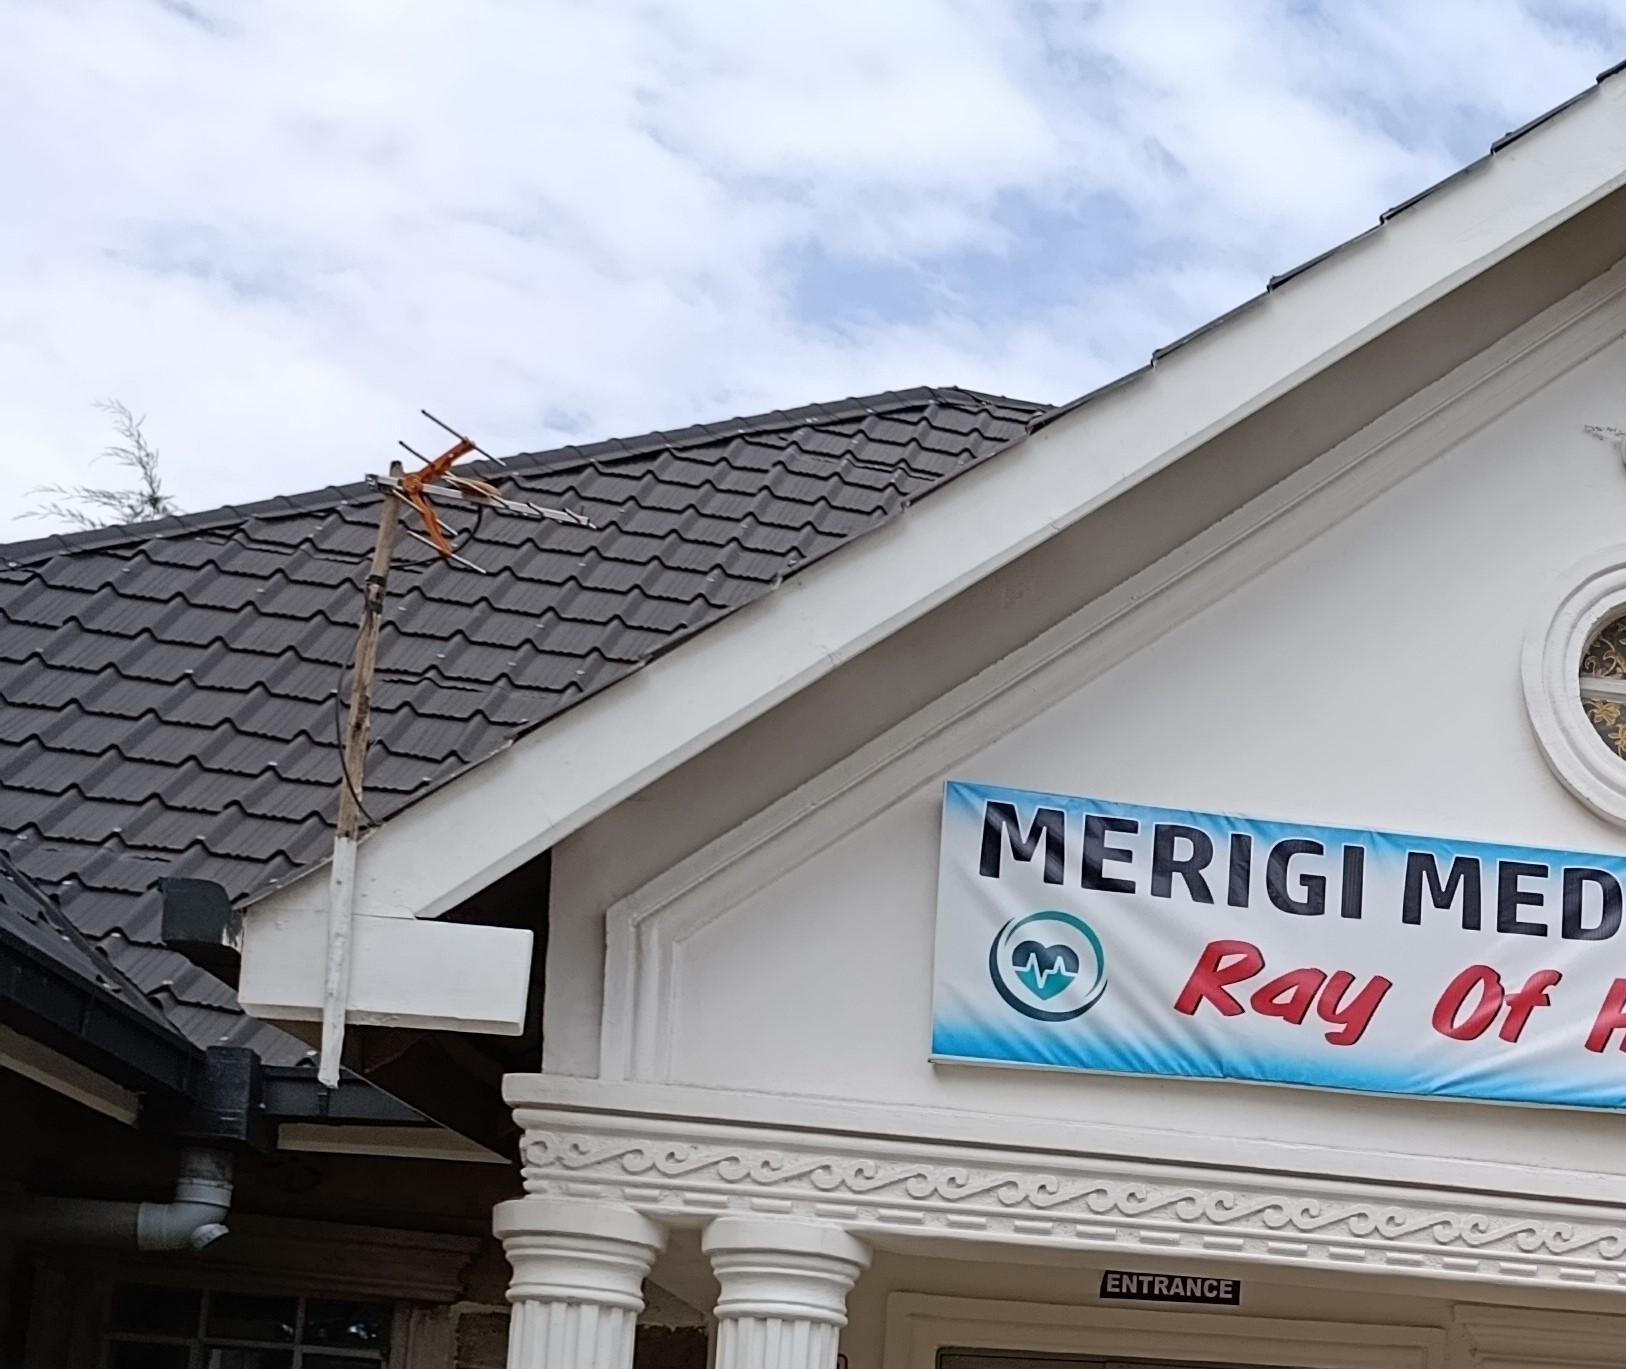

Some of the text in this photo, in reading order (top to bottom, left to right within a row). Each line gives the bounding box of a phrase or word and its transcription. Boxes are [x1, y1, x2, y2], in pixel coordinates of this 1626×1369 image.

[979, 800, 1366, 919] MERIGI
[1173, 939, 1393, 1046] Ray
[1431, 964, 1563, 1044] Of
[1106, 1273, 1233, 1298] ENTRANCE
